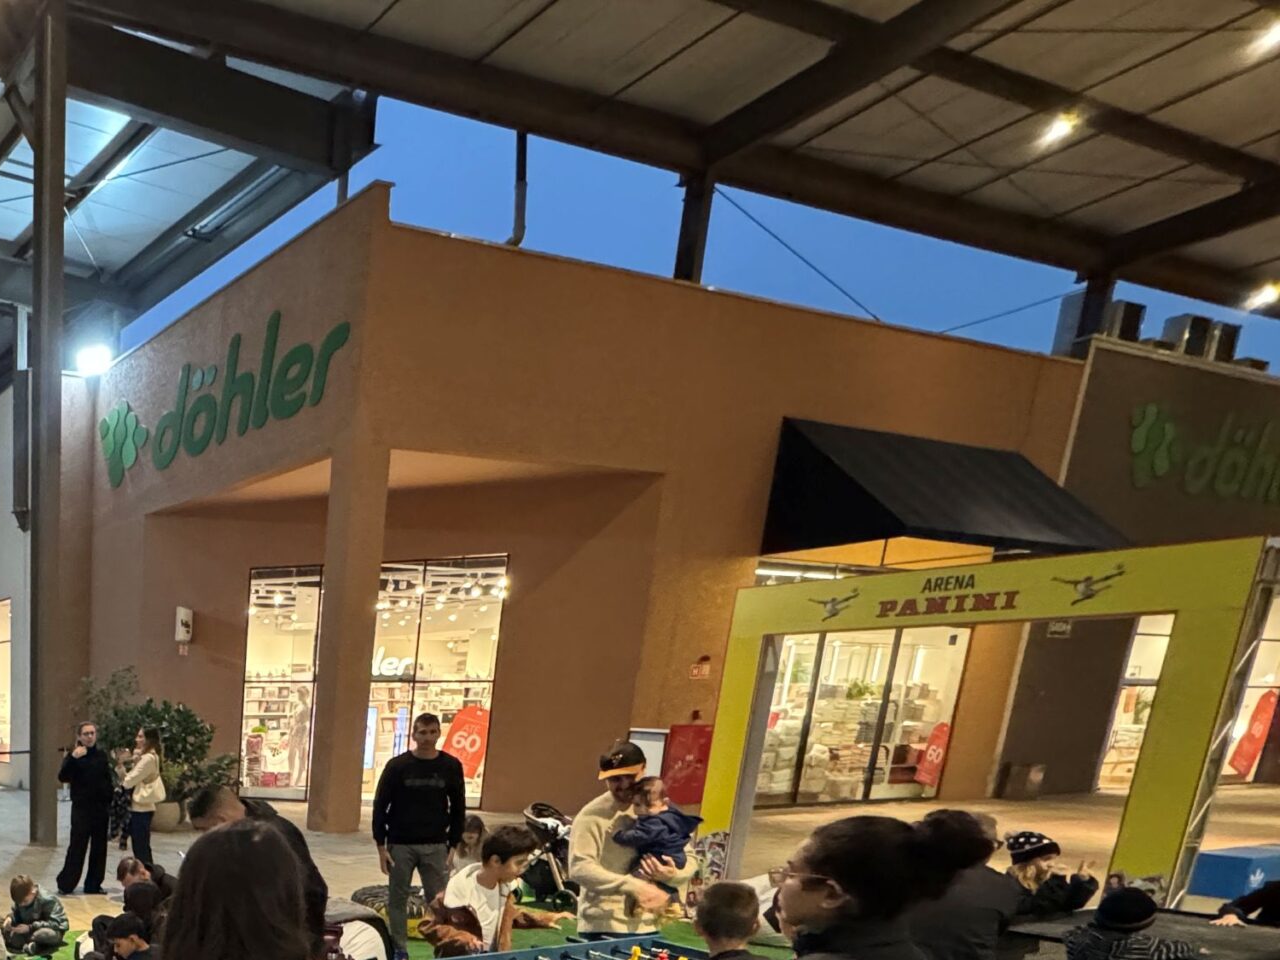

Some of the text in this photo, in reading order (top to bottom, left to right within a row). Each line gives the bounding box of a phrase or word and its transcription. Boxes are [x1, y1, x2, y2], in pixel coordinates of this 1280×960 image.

[151, 310, 351, 471] döhler
[921, 573, 976, 594] ARENA
[875, 590, 1020, 618] PANINI
[451, 731, 481, 753] 60
[927, 745, 944, 764] 60
